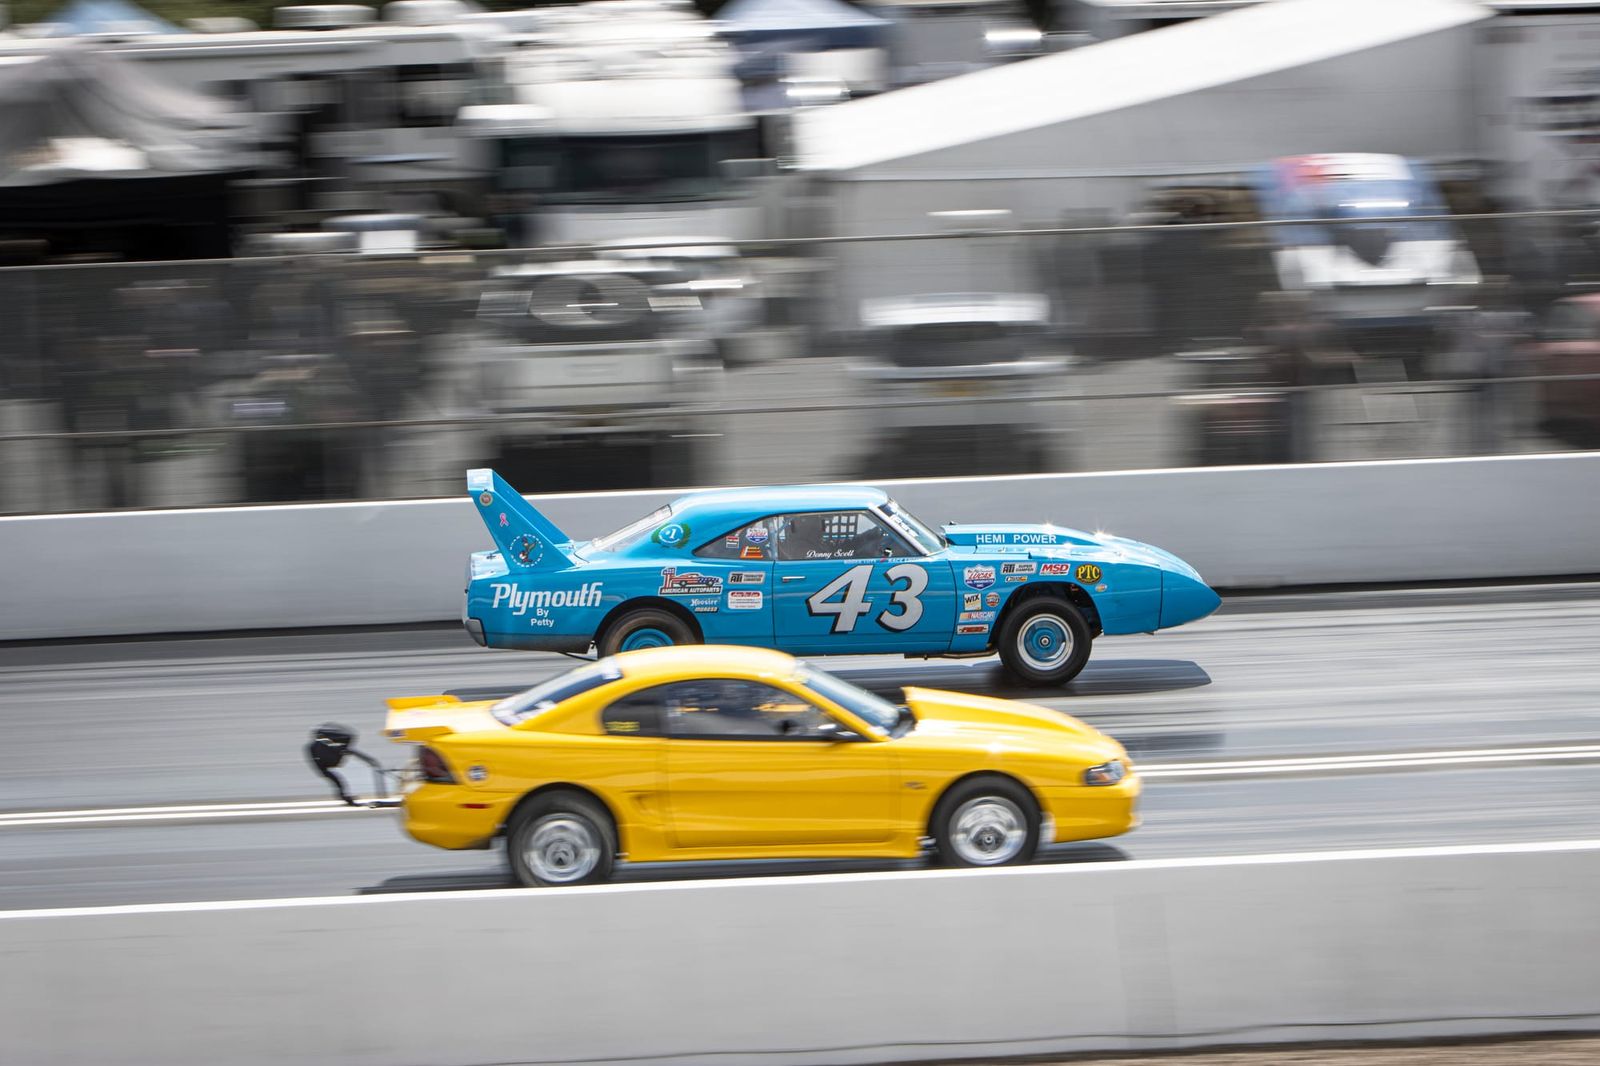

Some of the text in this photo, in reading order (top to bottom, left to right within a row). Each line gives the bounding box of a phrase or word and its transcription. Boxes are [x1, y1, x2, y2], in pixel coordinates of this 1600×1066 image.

[975, 534, 1057, 544] HEMI POWER
[833, 549, 855, 557] Scott
[1003, 563, 1016, 574] ATI
[1042, 564, 1069, 572] MSD
[1077, 564, 1100, 580] PTC
[730, 573, 743, 583] ATI
[490, 582, 604, 616] Plymouth
[690, 598, 718, 606] Hoosier
[805, 563, 929, 635] 43
[965, 594, 980, 603] WIX
[536, 608, 550, 618] By
[530, 617, 554, 628] Petty
